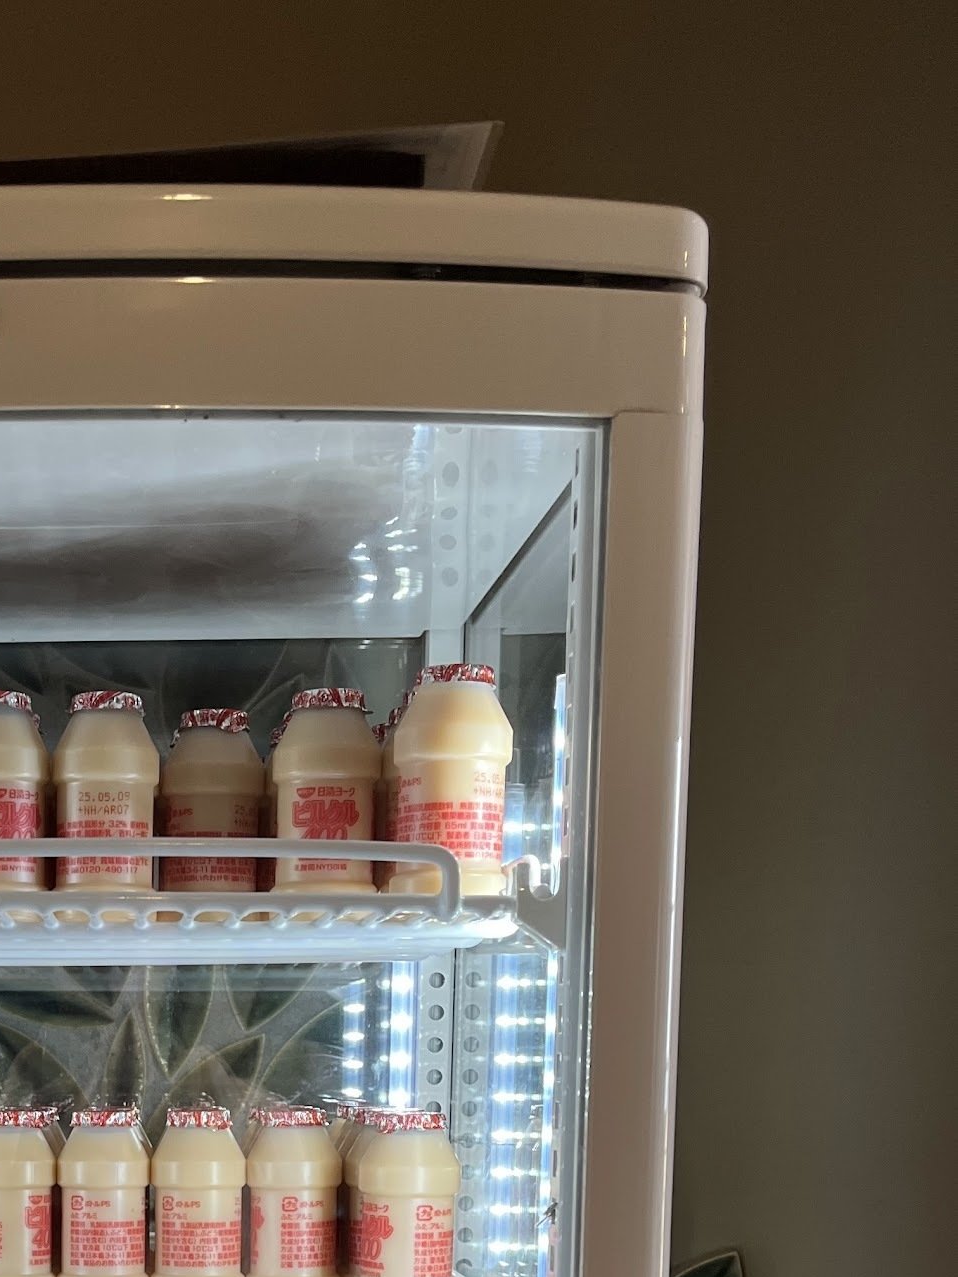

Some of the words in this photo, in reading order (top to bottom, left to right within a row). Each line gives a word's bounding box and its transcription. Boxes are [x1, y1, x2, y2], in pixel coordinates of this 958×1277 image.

[78, 792, 131, 802] 25.05.09
[317, 787, 356, 798] 日清ヨーク
[78, 805, 129, 814] +NH/AR07
[292, 800, 359, 827] ピルクル
